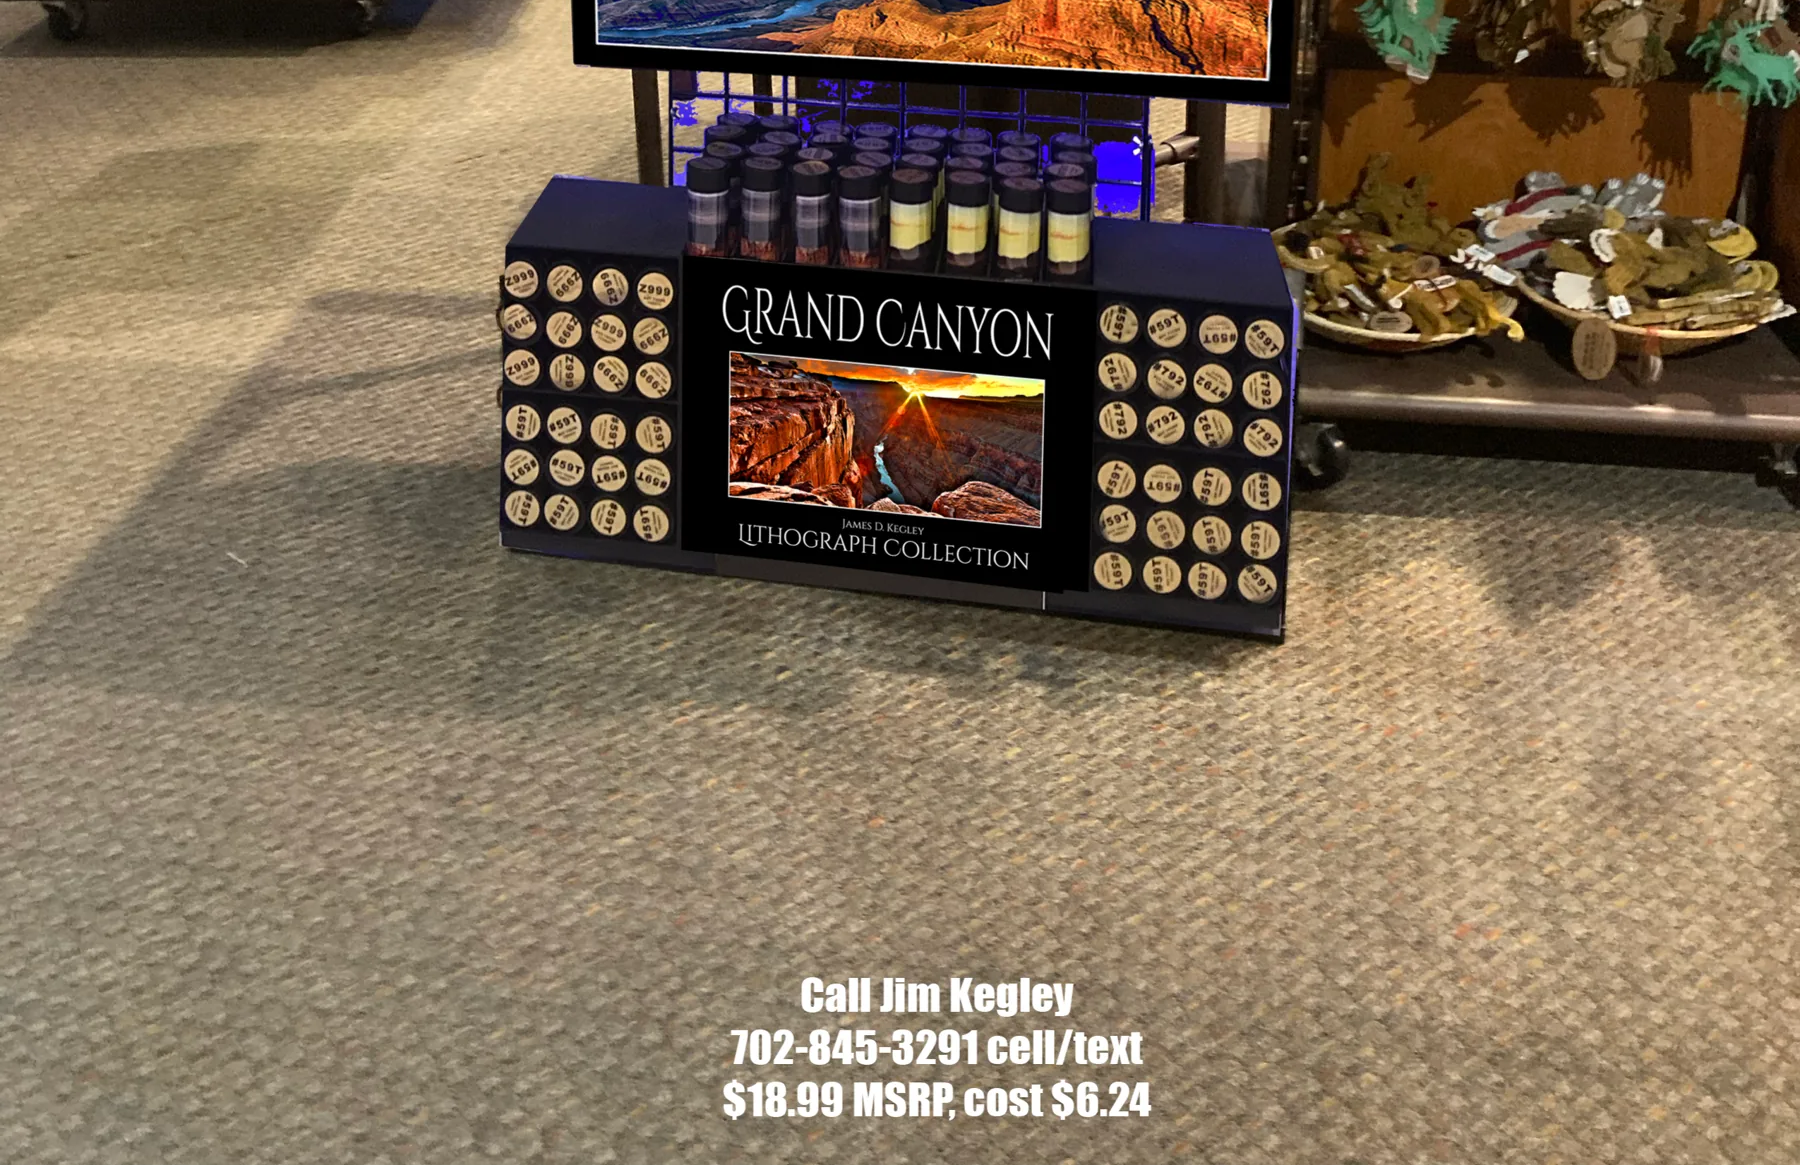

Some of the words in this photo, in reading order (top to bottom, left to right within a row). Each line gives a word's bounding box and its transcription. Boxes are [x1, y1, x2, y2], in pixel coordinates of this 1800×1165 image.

[722, 285, 864, 345] GRAND
[876, 298, 1055, 361] CANYON
[738, 523, 877, 555] LITHOGRAPH
[883, 538, 1030, 570] COLLECTION
[842, 518, 873, 531] JAMES
[874, 521, 885, 532] D.
[886, 523, 925, 536] KEGLEY
